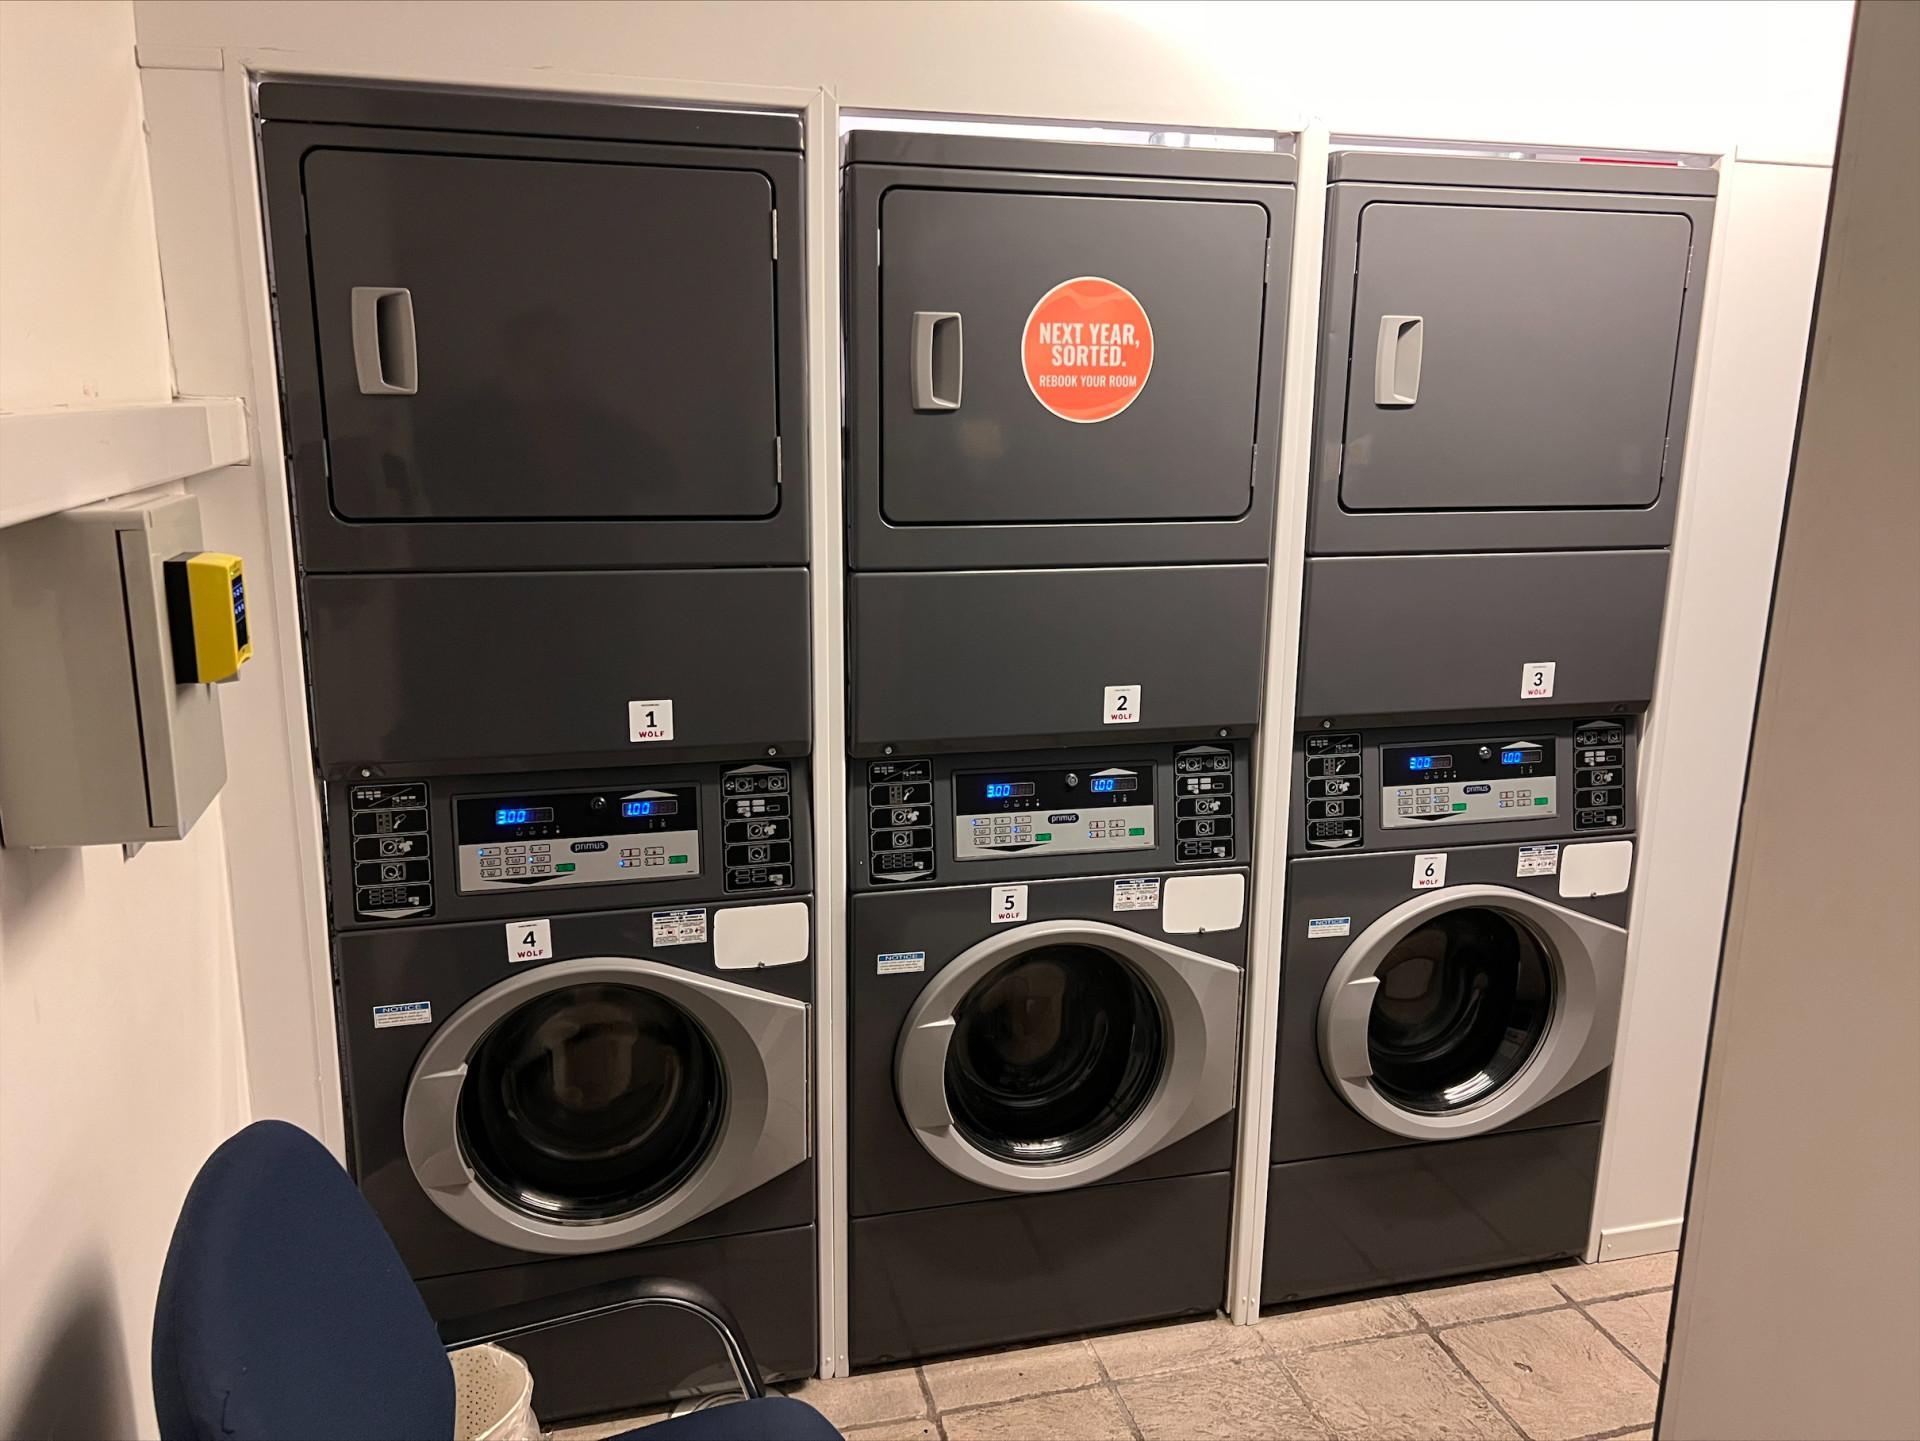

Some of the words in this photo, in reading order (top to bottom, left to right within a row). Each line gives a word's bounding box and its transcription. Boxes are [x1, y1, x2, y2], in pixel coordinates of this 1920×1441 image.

[1039, 322, 1084, 345] NEXT
[1089, 322, 1140, 349] YEAR,
[1051, 344, 1127, 367] SORTED.
[1039, 374, 1078, 388] REBOOK
[1081, 374, 1106, 388] YOUR
[1108, 374, 1137, 388] ROOM
[1533, 671, 1543, 687] 3
[1527, 688, 1547, 696] WOLF
[1116, 695, 1128, 711] 2
[645, 710, 658, 728] 1
[1110, 713, 1133, 721] WOLF
[638, 730, 665, 739] WOLF
[1051, 814, 1076, 824] primus
[574, 841, 605, 852] primus
[1424, 862, 1435, 877] 6
[1004, 894, 1015, 911] 5
[998, 912, 1019, 920] WOLF
[522, 930, 537, 948] 4
[517, 949, 544, 958] WOLF
[885, 953, 917, 961] NOTICE
[382, 1003, 420, 1013] NOTICE
